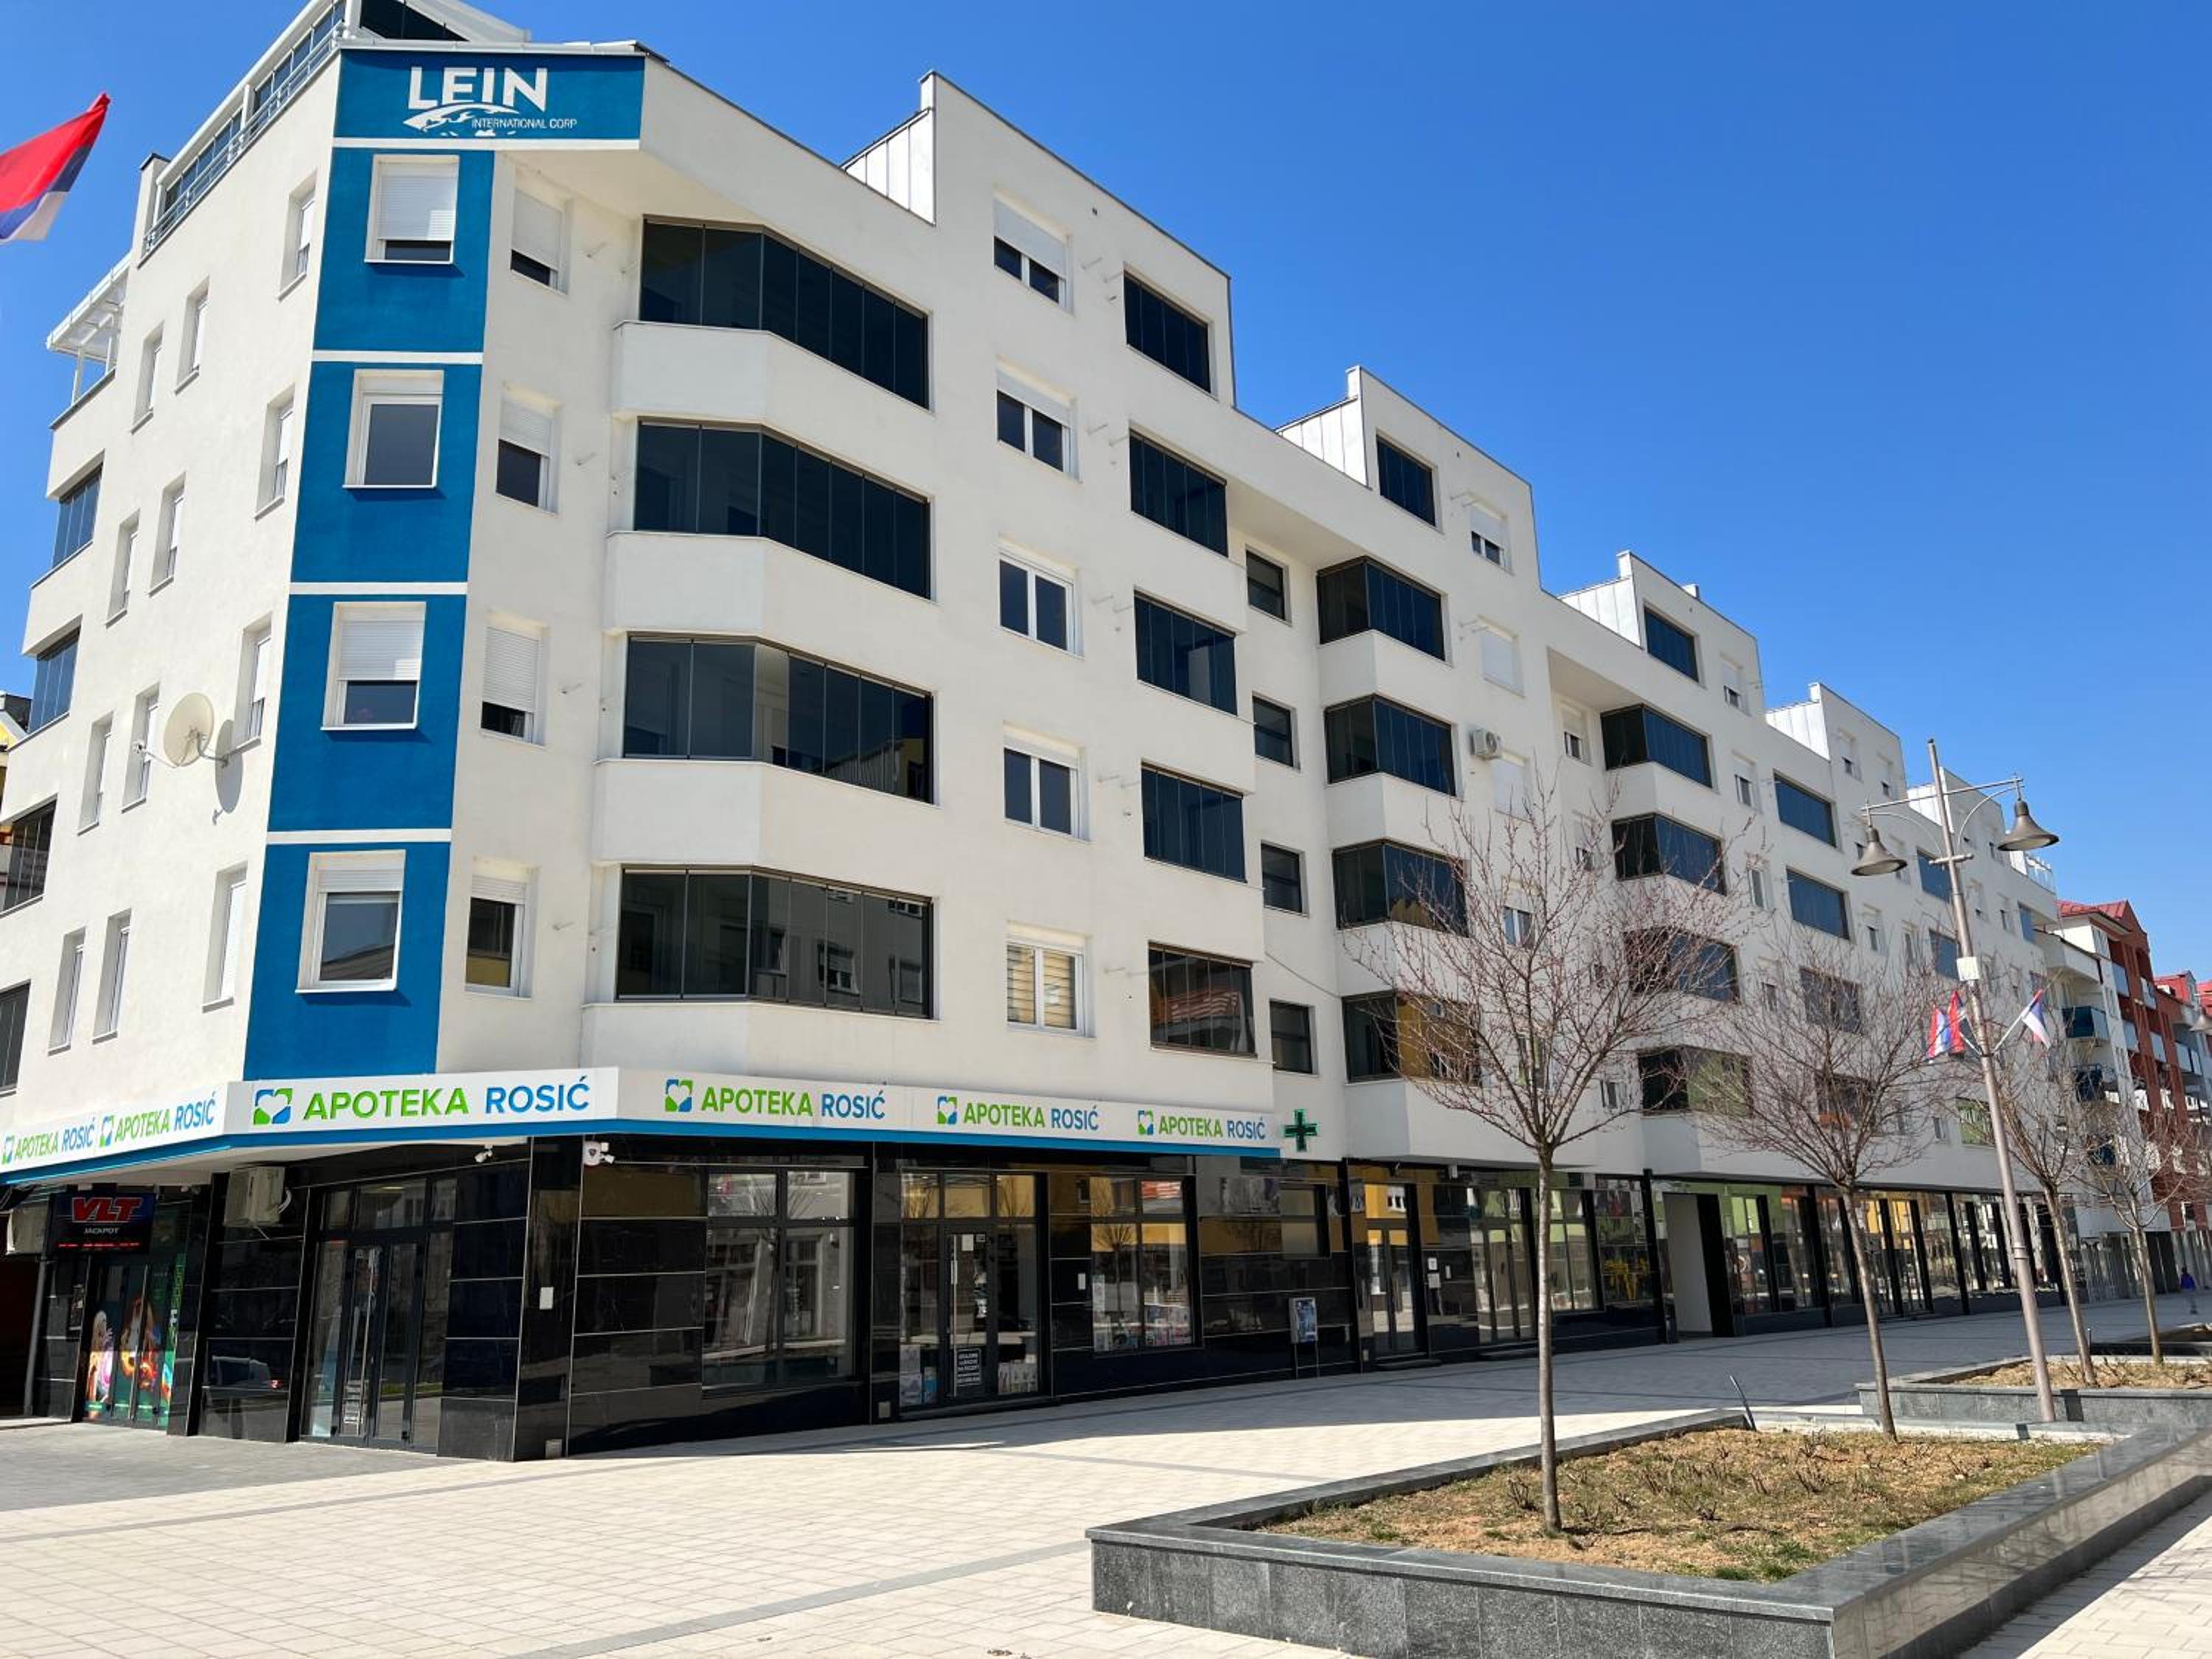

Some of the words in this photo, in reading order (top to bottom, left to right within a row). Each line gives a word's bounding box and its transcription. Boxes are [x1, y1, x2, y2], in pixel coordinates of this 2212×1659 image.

[408, 66, 549, 113] LEIN
[471, 117, 547, 130] INTERNATIONAL
[549, 118, 577, 130] CORP
[302, 1087, 470, 1121] APOTEKA
[484, 1074, 591, 1115] ROSIĆ
[700, 1086, 814, 1117] APOTEKA
[821, 1089, 886, 1120] ROSIĆ
[114, 1108, 170, 1143] APOTEKA
[173, 1091, 217, 1130] ROSIĆ
[964, 1102, 1046, 1128] APOTEKA
[1051, 1105, 1099, 1131] ROSIĆ
[1158, 1115, 1224, 1138] APOTEKA
[1226, 1117, 1266, 1140] ROSIĆ
[14, 1131, 59, 1161] APOTEKA
[62, 1116, 96, 1151] ROSIĆ
[72, 1197, 142, 1223] VLT
